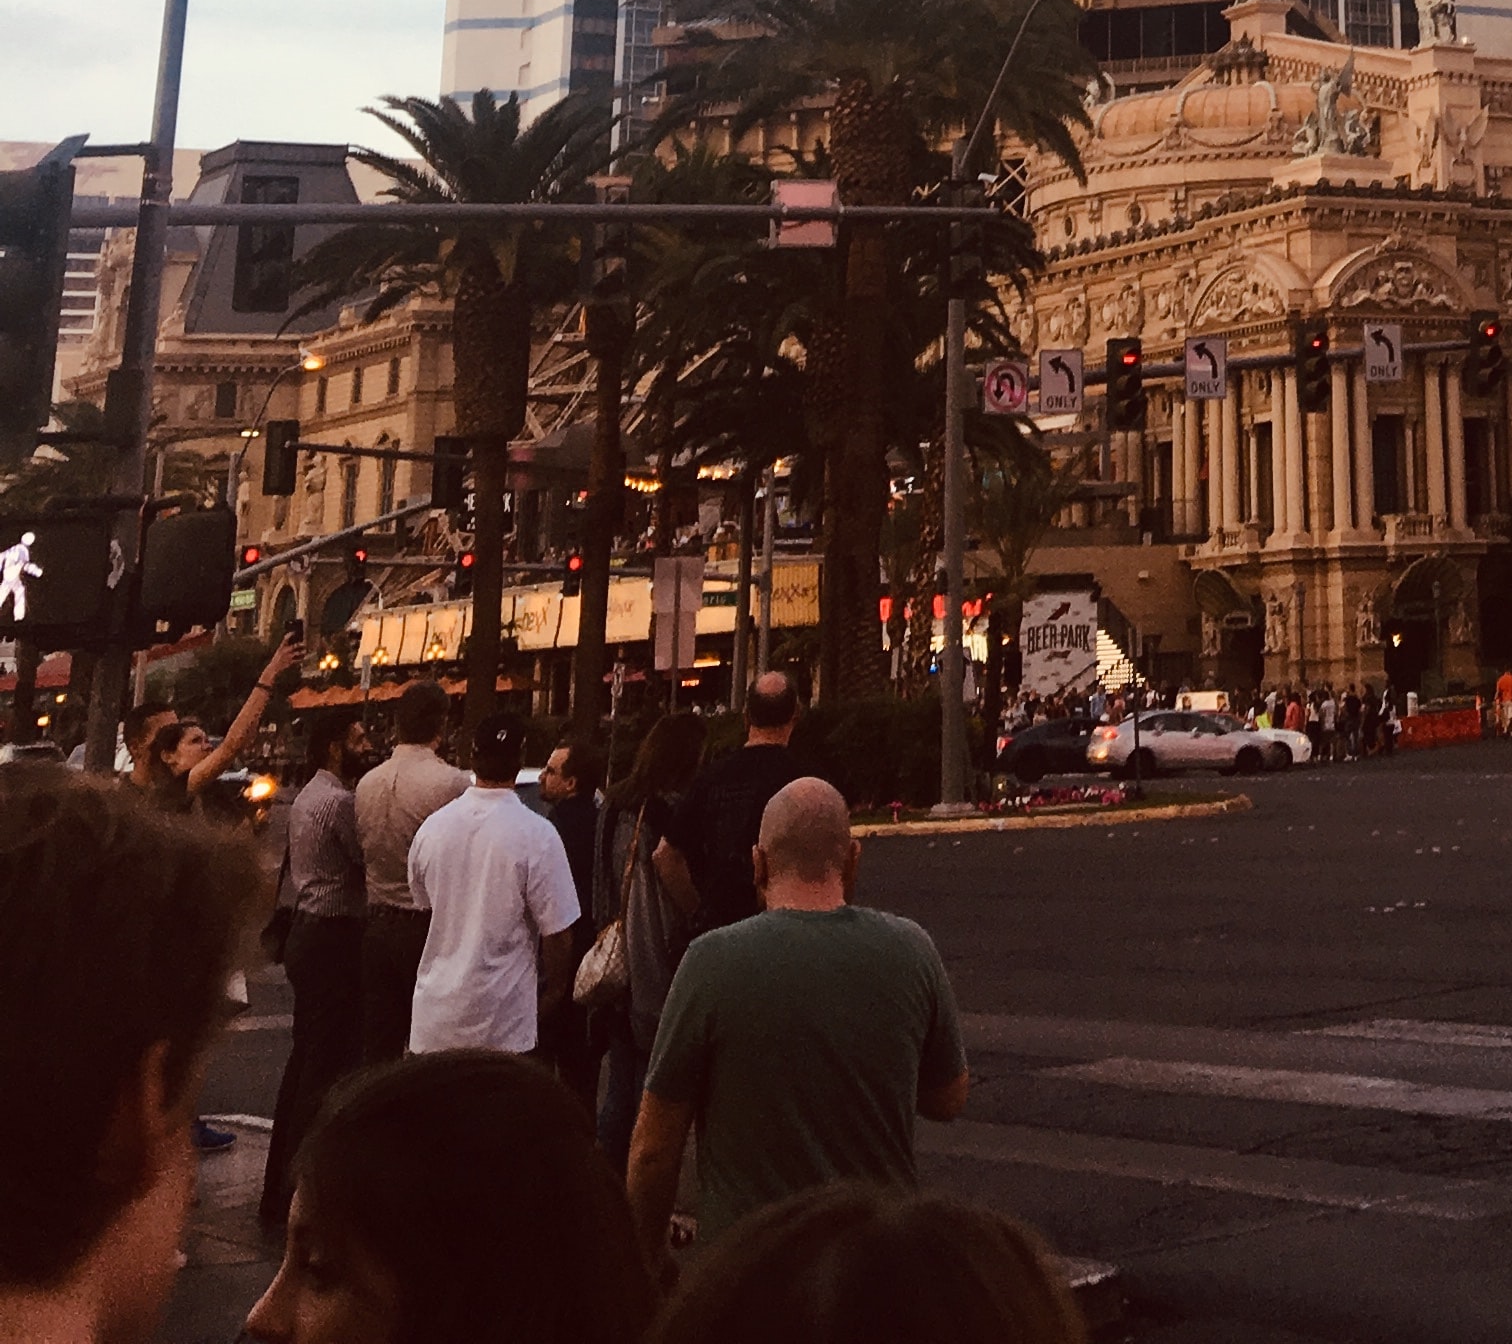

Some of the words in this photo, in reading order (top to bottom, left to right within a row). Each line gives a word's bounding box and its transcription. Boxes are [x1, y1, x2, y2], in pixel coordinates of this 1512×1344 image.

[1370, 365, 1397, 378] ONLY
[1191, 381, 1220, 394] ONLY
[1046, 395, 1078, 409] ONLY
[1027, 623, 1057, 655] BEER
[1060, 624, 1090, 654] PARK
